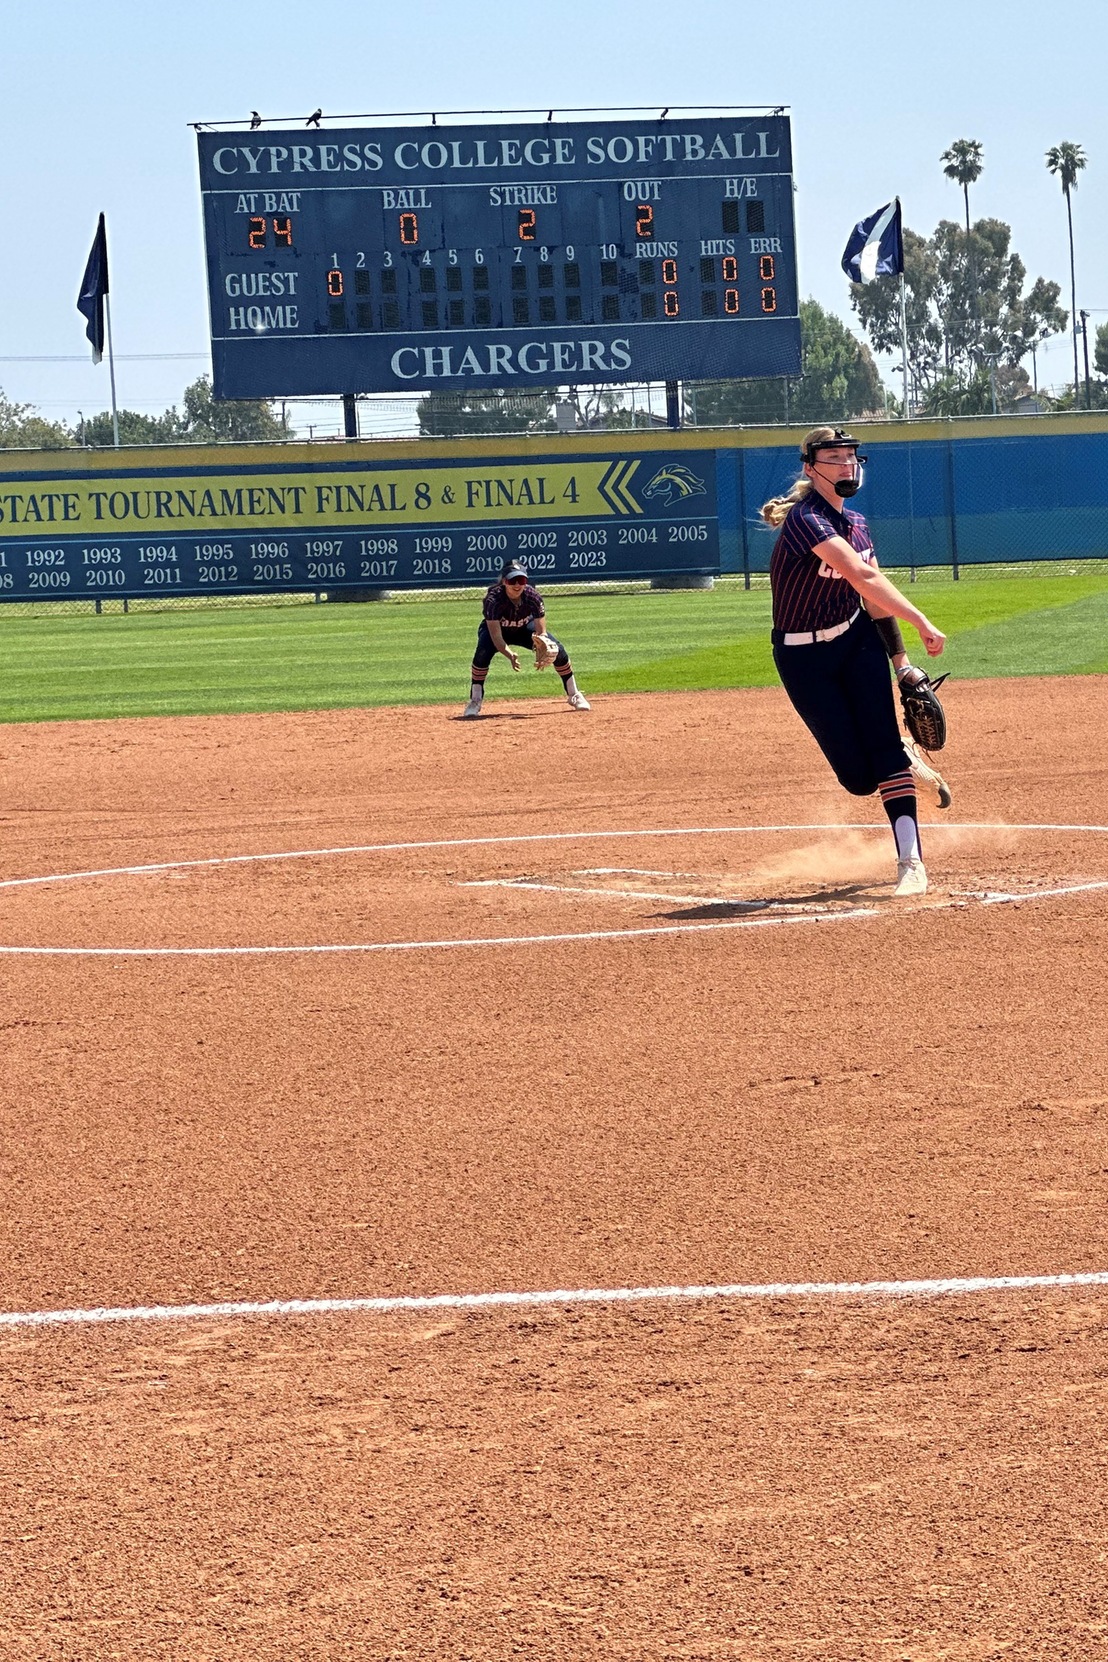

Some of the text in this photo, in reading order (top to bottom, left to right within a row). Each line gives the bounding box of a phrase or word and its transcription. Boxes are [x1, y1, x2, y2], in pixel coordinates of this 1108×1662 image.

[212, 131, 780, 174] CYPRESS COLLEGE SOFTBALL
[234, 192, 301, 213] AT BAT
[382, 189, 432, 209] BALL
[489, 185, 558, 206] STRIKE
[623, 181, 662, 201] OUT
[724, 178, 758, 198] H/E
[248, 216, 292, 248] 24
[400, 212, 418, 244] 0
[518, 208, 536, 240] 2
[636, 204, 653, 236] 2
[331, 238, 782, 268] 1 2 3 4 5 6 7 8 9 10 RUNS HITS ERR
[225, 272, 298, 297] GUEST
[327, 255, 774, 296] 0 0 0 0
[228, 304, 299, 330] HOME
[664, 287, 776, 316] 0 0 0
[390, 338, 632, 379] CHARGERS
[88, 486, 306, 520] TOURNAMENT
[315, 483, 406, 513] FINAL
[414, 482, 432, 510] 8
[441, 485, 456, 504] &
[465, 477, 555, 508] FINAL
[563, 476, 580, 504] 4
[26, 549, 66, 567] 1992
[82, 548, 122, 565] 1993
[138, 546, 178, 563] 1994
[194, 544, 234, 561] 1995
[250, 542, 289, 559] 1996
[305, 540, 344, 558] 1997
[360, 538, 398, 556] 1998
[414, 536, 452, 554] 1999
[466, 534, 508, 551] 2000
[518, 532, 558, 549] 2002
[568, 530, 608, 548] 2003
[618, 527, 658, 544] 2004
[668, 525, 708, 542] 2005
[28, 571, 70, 588] 2009
[86, 569, 126, 586] 2010
[144, 568, 182, 584] 2011
[198, 566, 238, 582] 2012
[254, 564, 293, 580] 2015
[307, 562, 346, 578] 2016
[360, 560, 398, 577] 2017
[413, 558, 452, 574] 2018
[466, 556, 504, 572] 2019
[520, 554, 556, 570] 2022
[570, 552, 606, 568] 2023
